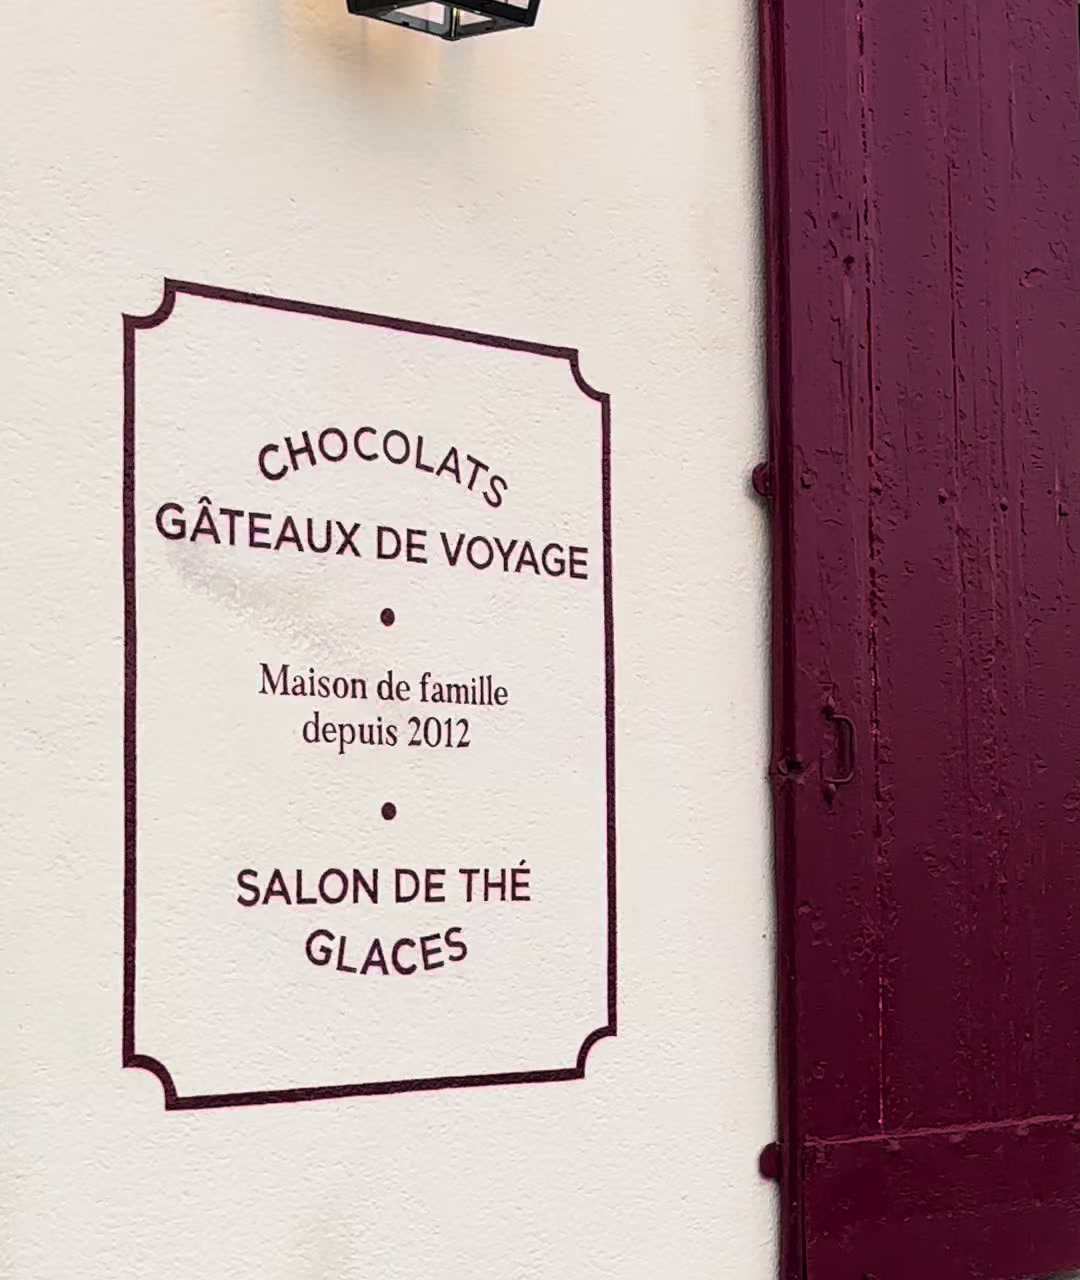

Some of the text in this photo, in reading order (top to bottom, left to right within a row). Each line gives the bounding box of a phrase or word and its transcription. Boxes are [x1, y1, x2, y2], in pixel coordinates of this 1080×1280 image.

[258, 426, 509, 509] CHOCOLATS
[155, 495, 589, 580] GÂTEAUX DE VOYAGE
[258, 662, 509, 706] Maison de famille
[302, 710, 471, 755] depuis 2012
[236, 858, 531, 908] SALON DE THÉ
[305, 926, 468, 976] GLACES
